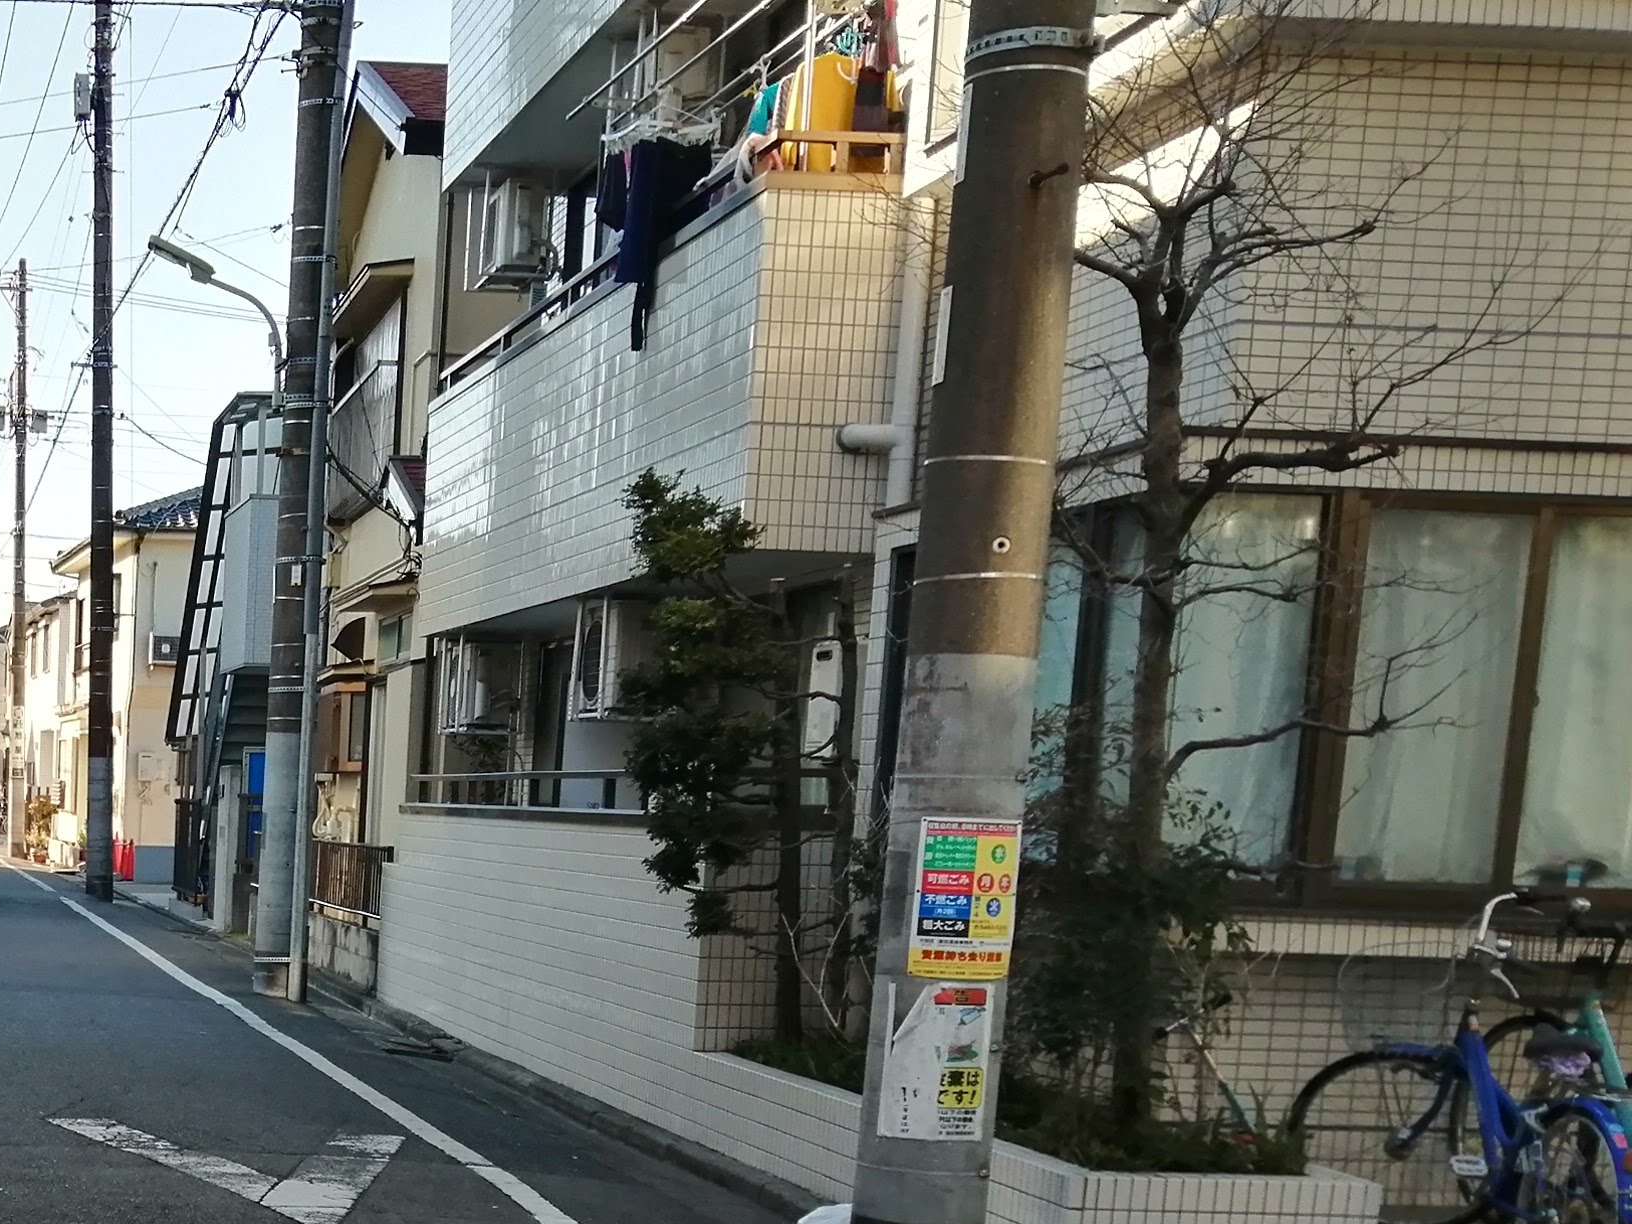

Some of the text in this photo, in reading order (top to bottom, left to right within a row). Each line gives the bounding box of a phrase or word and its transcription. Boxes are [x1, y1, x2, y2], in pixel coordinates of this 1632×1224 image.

[927, 873, 970, 886] 可燃ごみ
[924, 894, 968, 906] 不燃ごみ
[922, 919, 966, 931] 粗大ごみ
